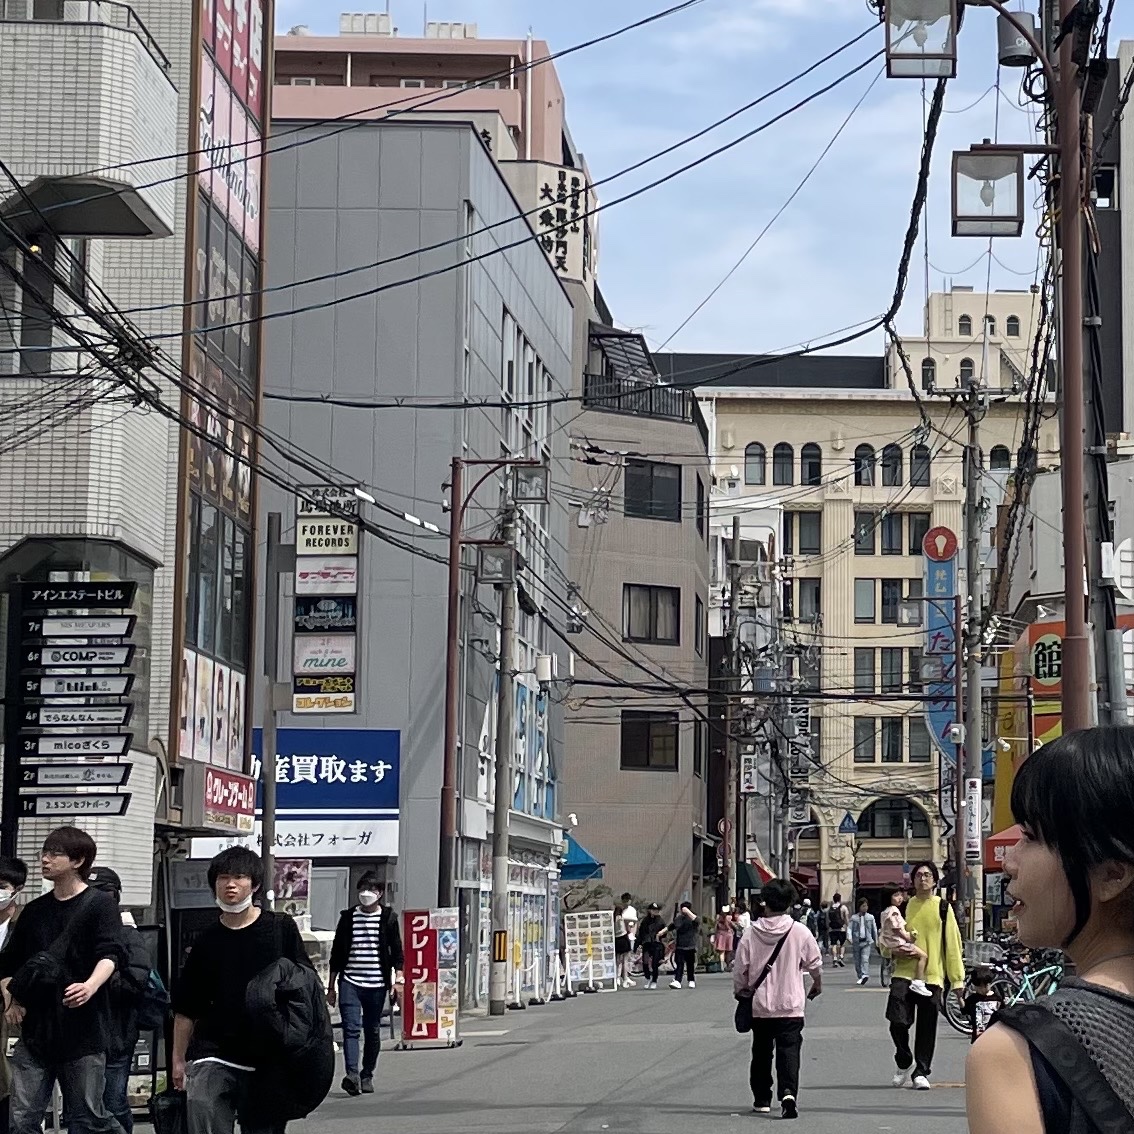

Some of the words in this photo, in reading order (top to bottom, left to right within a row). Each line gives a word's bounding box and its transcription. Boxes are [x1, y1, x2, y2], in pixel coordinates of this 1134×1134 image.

[302, 525, 354, 535] FOREVER
[305, 538, 350, 547] RECORDS
[32, 589, 124, 600] アインエステートビル
[28, 622, 40, 632] 7F
[28, 652, 39, 661] 6F
[62, 651, 98, 661] COMP
[303, 657, 348, 667] mine
[27, 681, 39, 691] 5F
[26, 711, 37, 720] 4F
[24, 741, 36, 750] 3F
[24, 771, 35, 780] 2F
[23, 801, 34, 811] 1F
[412, 915, 429, 1036] クレーンム
